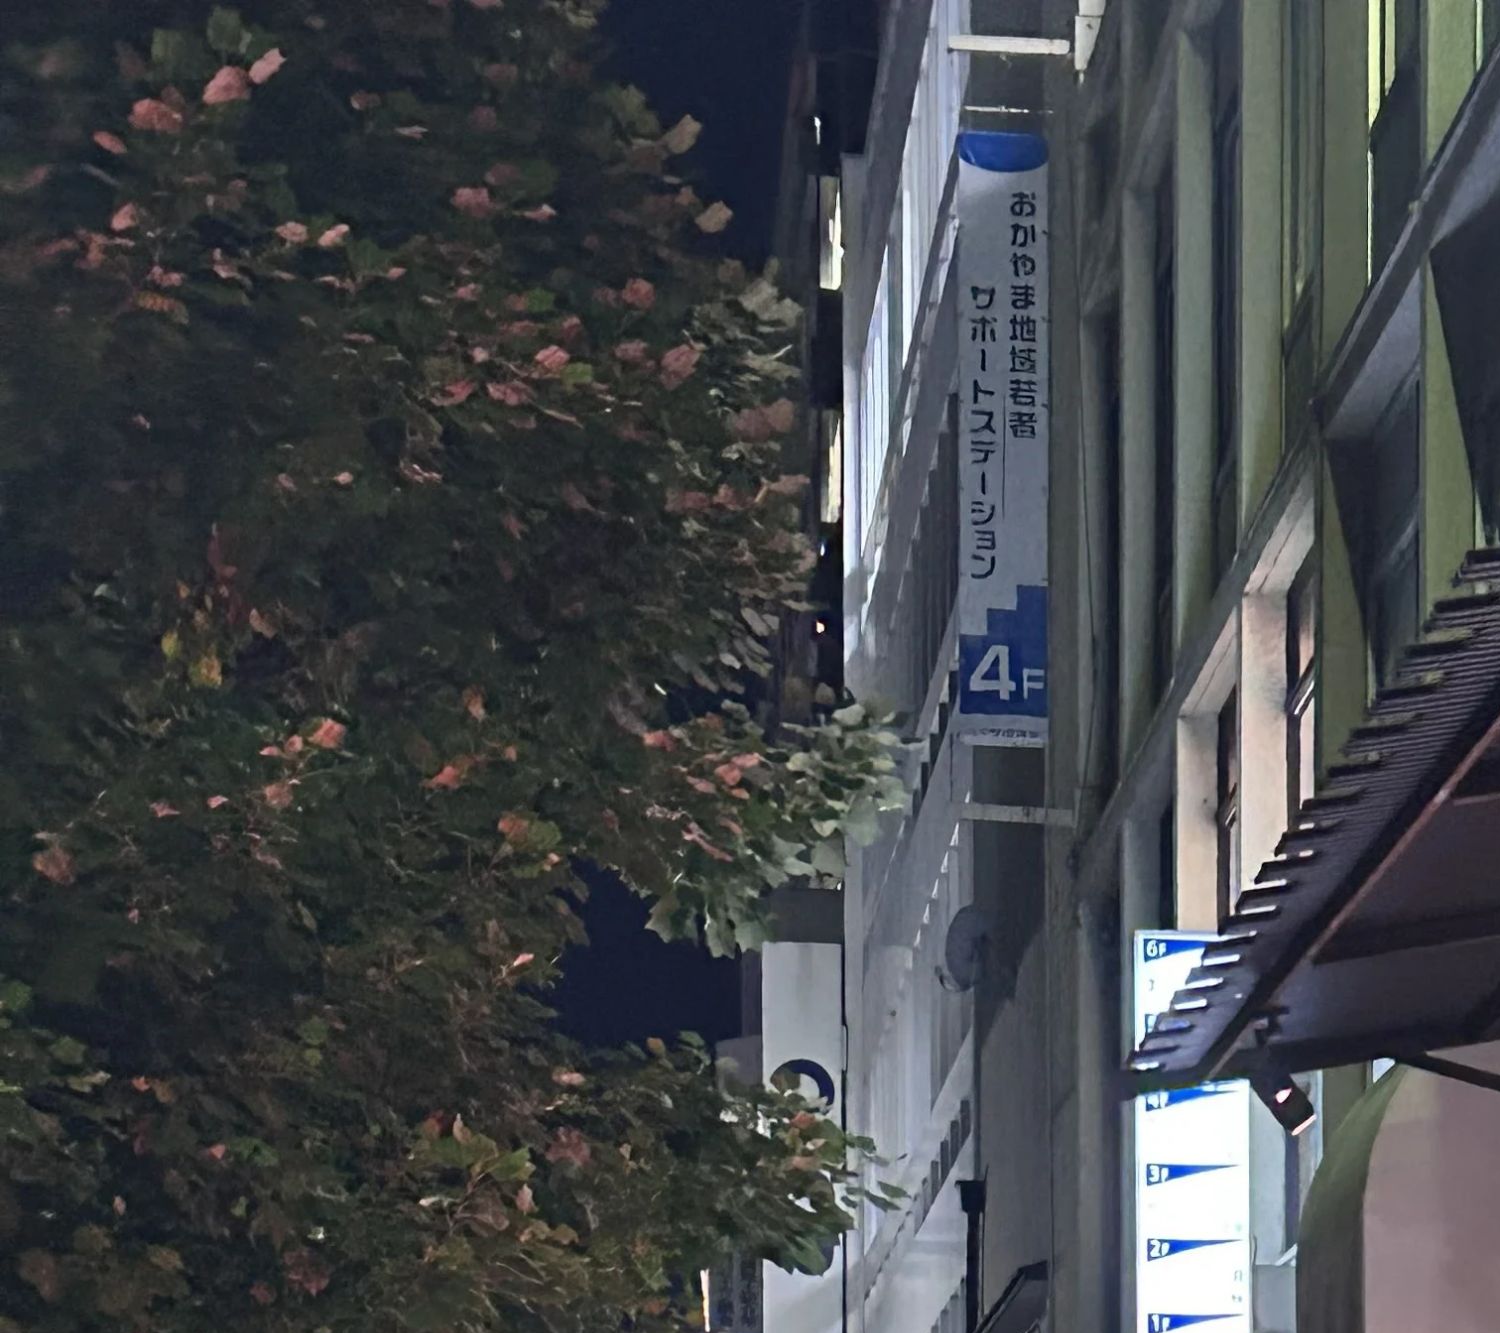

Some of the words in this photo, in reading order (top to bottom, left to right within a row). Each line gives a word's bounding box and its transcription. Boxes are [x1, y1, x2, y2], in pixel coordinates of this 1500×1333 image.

[970, 286, 998, 581] サポートステーション
[1009, 191, 1037, 440] おかやま地域若者
[969, 645, 1045, 700] 4F
